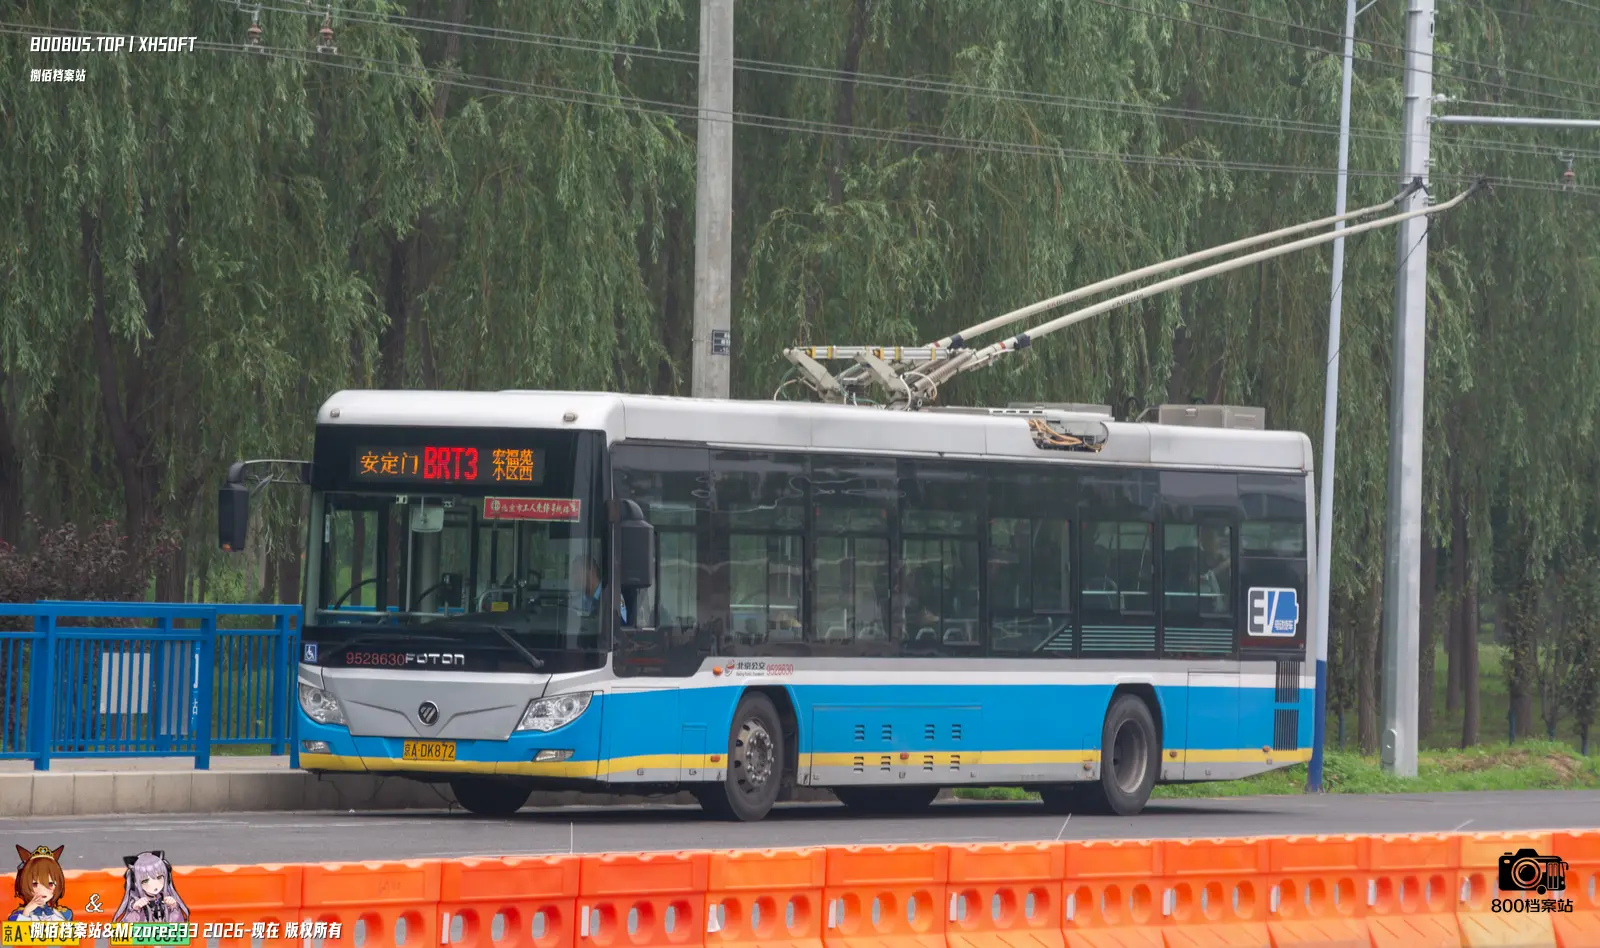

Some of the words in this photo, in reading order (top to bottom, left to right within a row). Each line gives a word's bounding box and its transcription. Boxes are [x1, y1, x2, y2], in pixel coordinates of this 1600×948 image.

[360, 451, 419, 474] 安定门
[424, 446, 479, 480] BRT3
[492, 448, 534, 465] 宏福苑
[492, 464, 533, 481] 小区西
[346, 652, 405, 666] 9528630
[405, 653, 465, 665] FOTON
[737, 662, 765, 670] 北京公交
